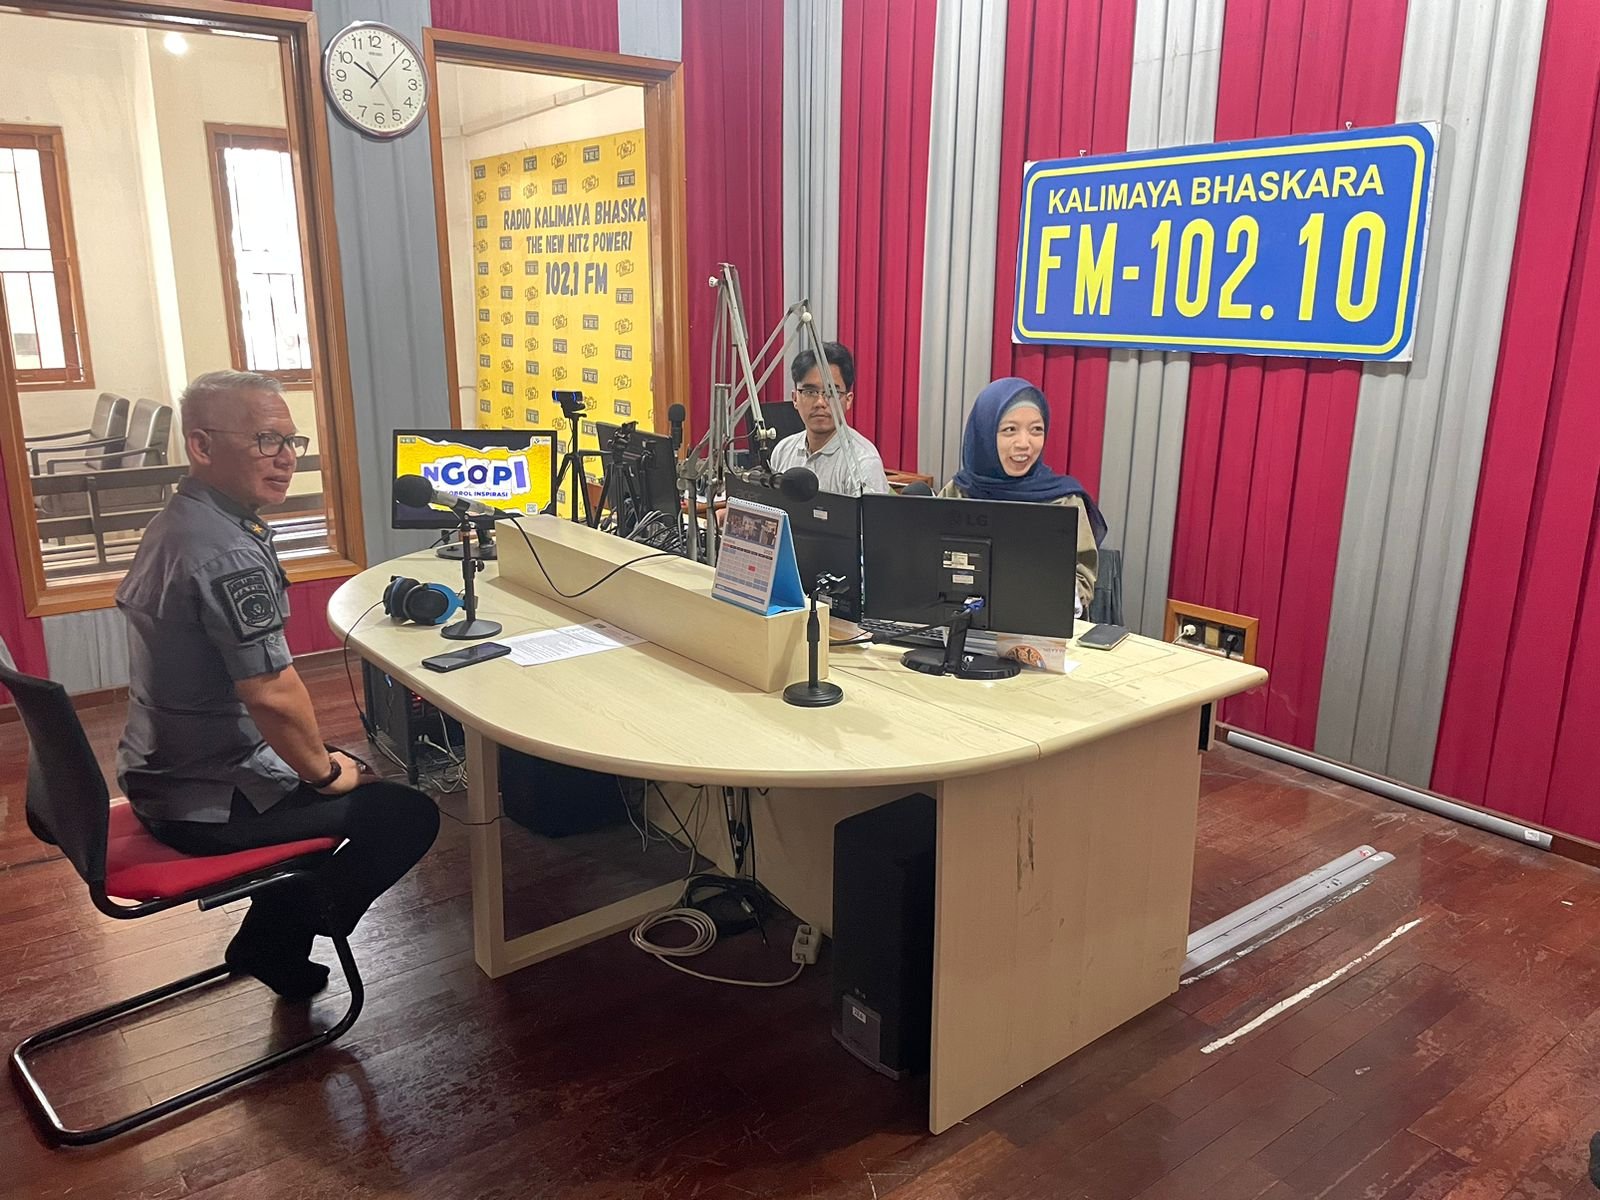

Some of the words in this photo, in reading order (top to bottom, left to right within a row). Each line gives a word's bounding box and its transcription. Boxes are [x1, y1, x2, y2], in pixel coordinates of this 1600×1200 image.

[352, 36, 363, 50] 11
[368, 35, 382, 49] 12
[391, 42, 397, 54] 1
[338, 51, 353, 64] 10
[402, 58, 412, 71] 2
[335, 69, 347, 82] 9
[408, 78, 418, 91] 3
[342, 89, 353, 102] 8
[403, 96, 413, 108] 4
[358, 105, 368, 118] 7
[392, 109, 402, 122] 5
[374, 112, 385, 125] 6
[1047, 178, 1183, 215] KALIMAYA
[1190, 163, 1385, 206] BHASKARA
[503, 207, 531, 231] RADIO
[534, 202, 591, 230] KALIMAYA
[594, 197, 647, 225] BHASKA
[526, 235, 543, 254] THE
[545, 234, 565, 254] NEW
[1035, 210, 1387, 323] FM-102.10
[584, 262, 608, 295] FM
[423, 460, 527, 489] NGOPI
[966, 513, 988, 526] LG
